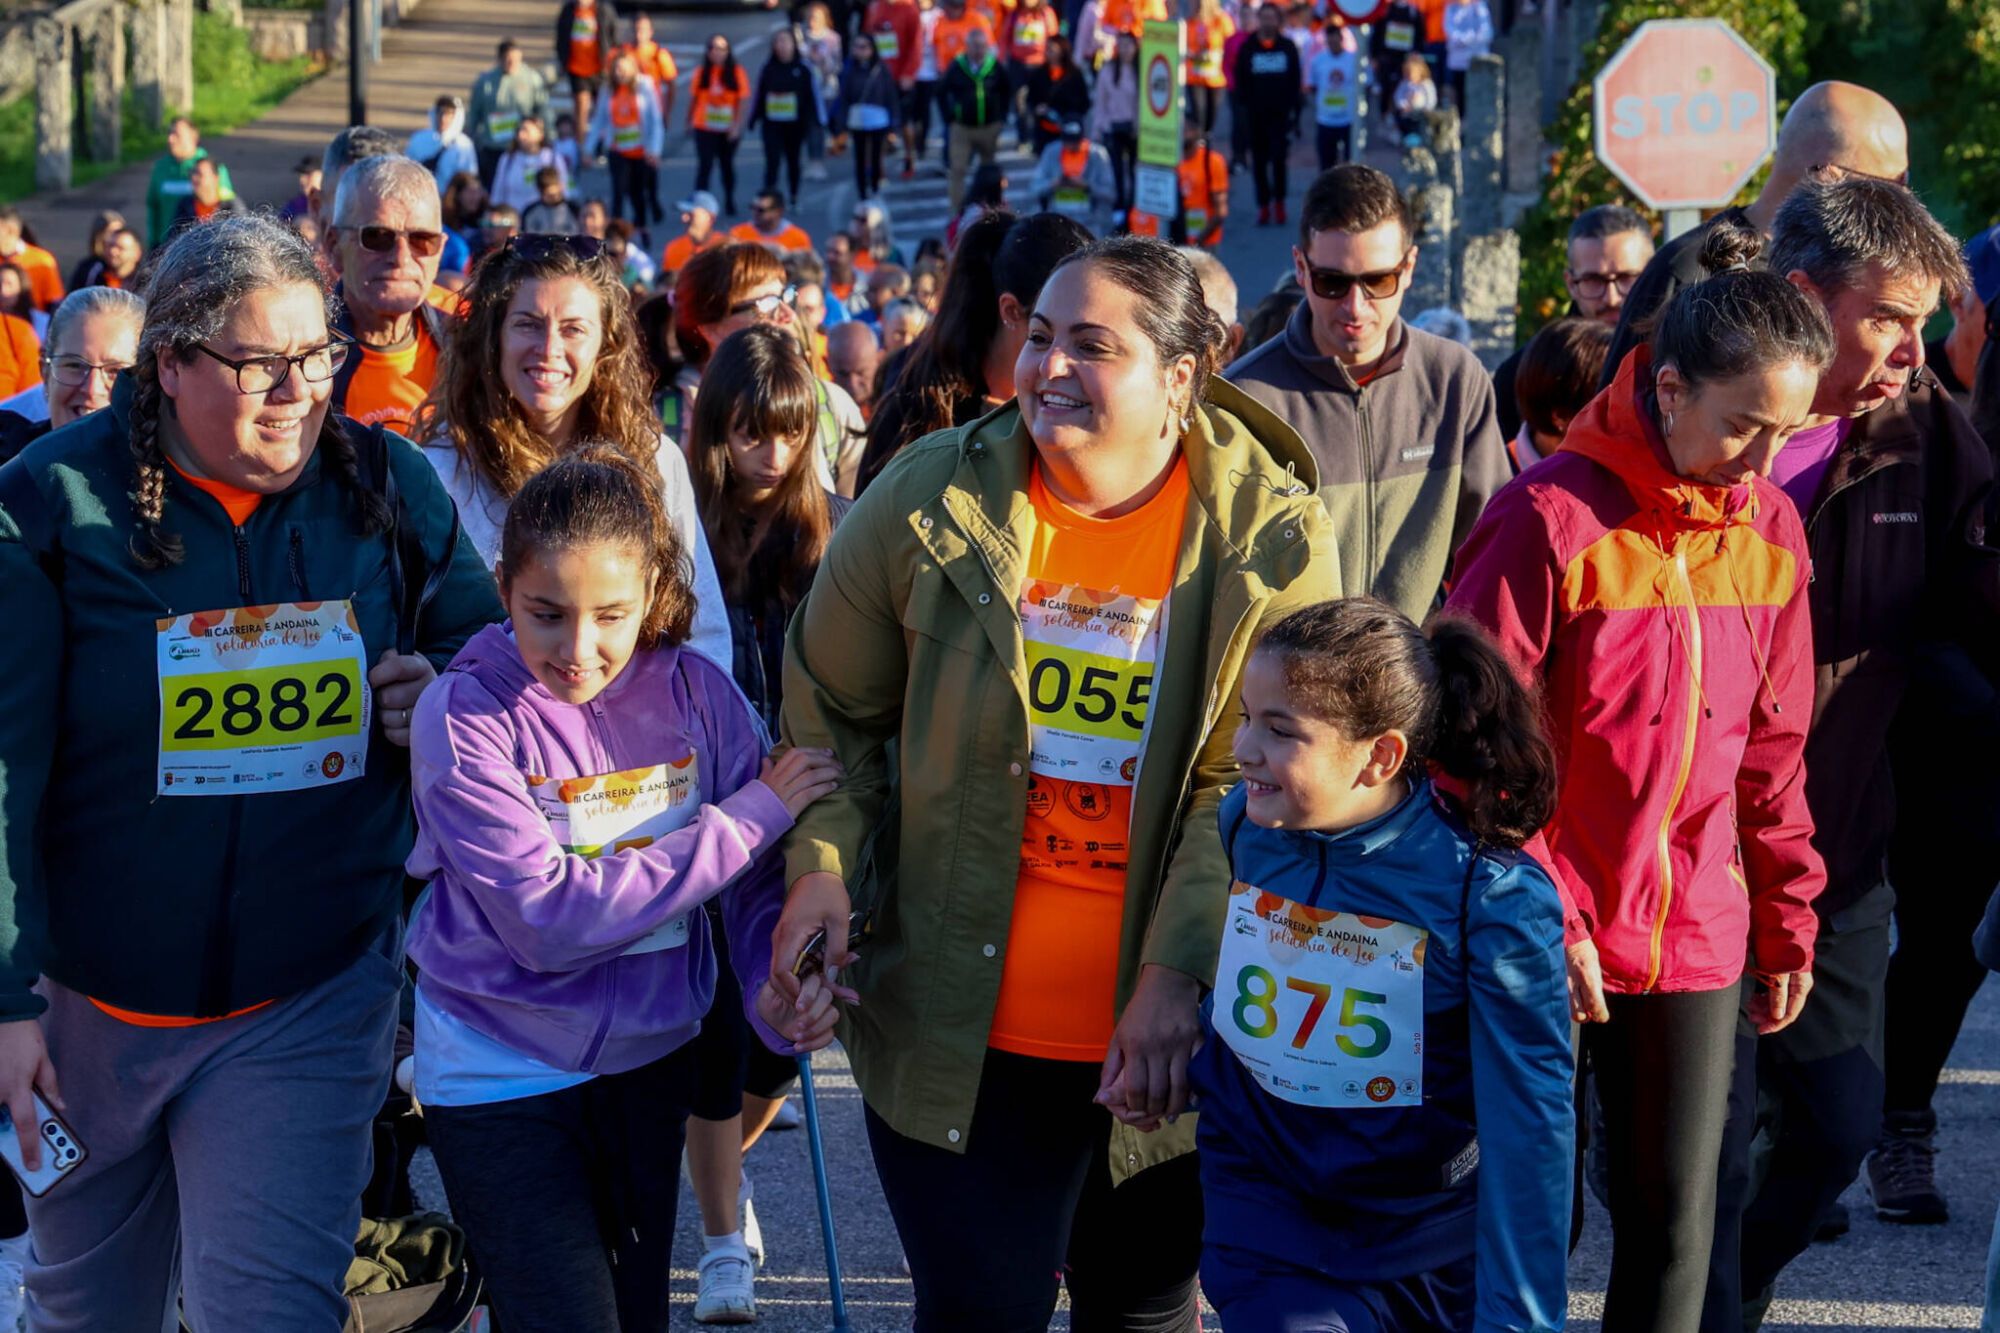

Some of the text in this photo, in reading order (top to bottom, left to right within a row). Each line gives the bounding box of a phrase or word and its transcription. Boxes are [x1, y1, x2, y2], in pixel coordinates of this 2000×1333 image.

[1611, 91, 1760, 139] STOP
[1048, 600, 1094, 617] CARREIRA
[1096, 608, 1104, 617] E
[214, 624, 262, 636] CARREIRA
[264, 622, 271, 632] E
[273, 618, 320, 630] ANDAINA
[216, 636, 278, 656] solidaria
[281, 629, 300, 646] de
[301, 628, 321, 648] Leo
[1107, 622, 1128, 638] de
[174, 673, 352, 739] 2882
[1025, 656, 1153, 730] 055
[583, 788, 636, 802] CARREIRA
[638, 785, 646, 794] E
[647, 775, 689, 792] ANDAINA
[1269, 927, 1326, 953] solidaria
[1330, 941, 1352, 959] de
[1352, 944, 1377, 966] Leo
[1272, 913, 1314, 935] CARREIRA
[1316, 927, 1324, 937] E
[1325, 930, 1379, 947] ANDAINA
[1232, 965, 1391, 1058] 875
